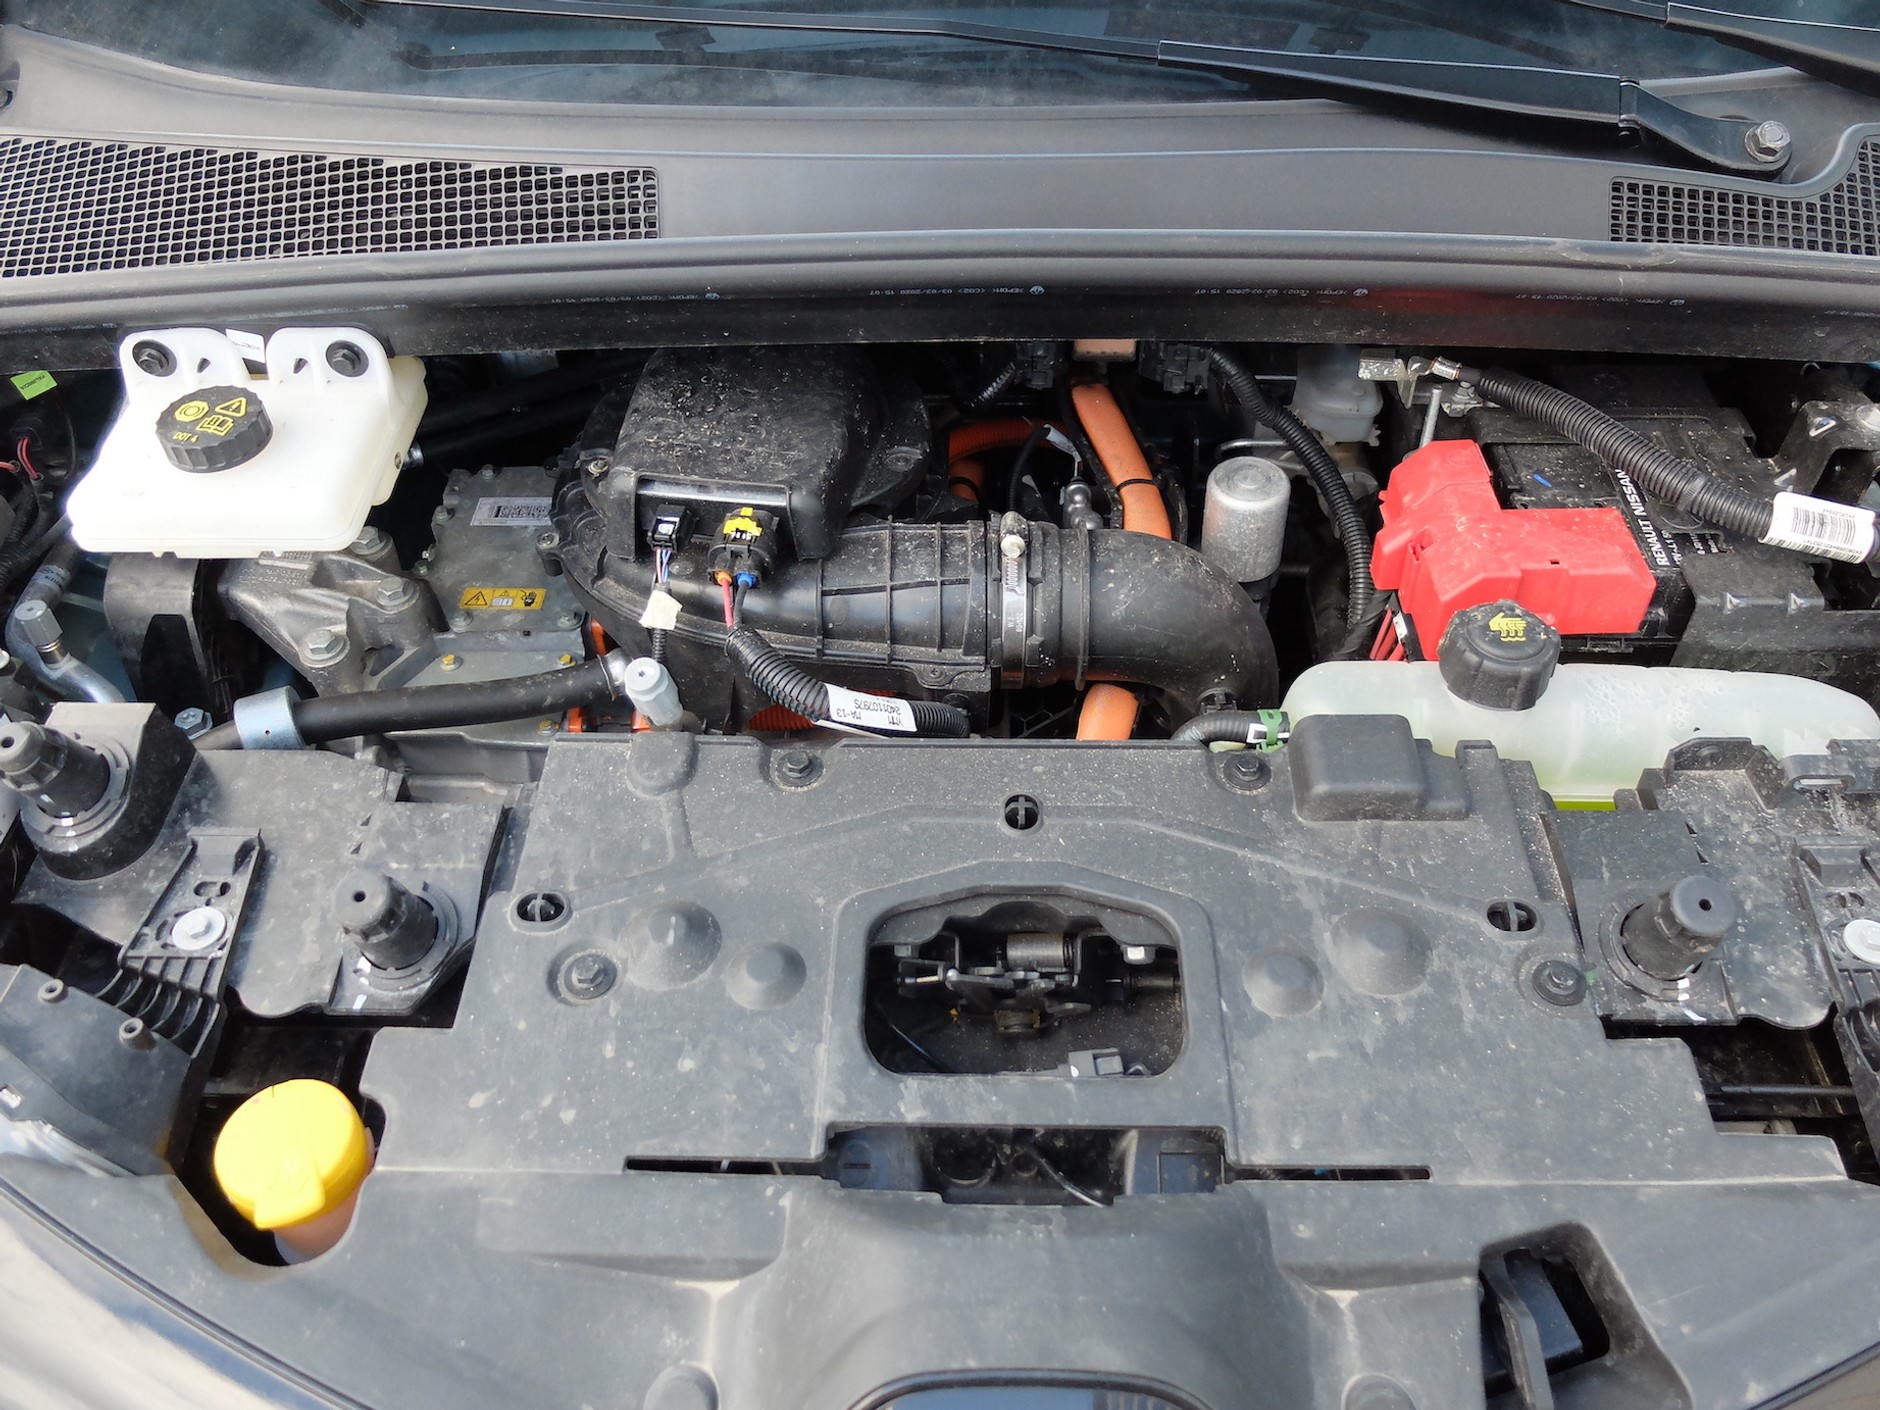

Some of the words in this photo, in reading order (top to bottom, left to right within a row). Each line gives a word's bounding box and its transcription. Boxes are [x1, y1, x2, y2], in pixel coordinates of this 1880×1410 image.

[172, 432, 192, 442] DOT
[1615, 469, 1647, 517] NISSAN
[1638, 518, 1671, 566] RENAULT
[836, 708, 862, 721] MA-13
